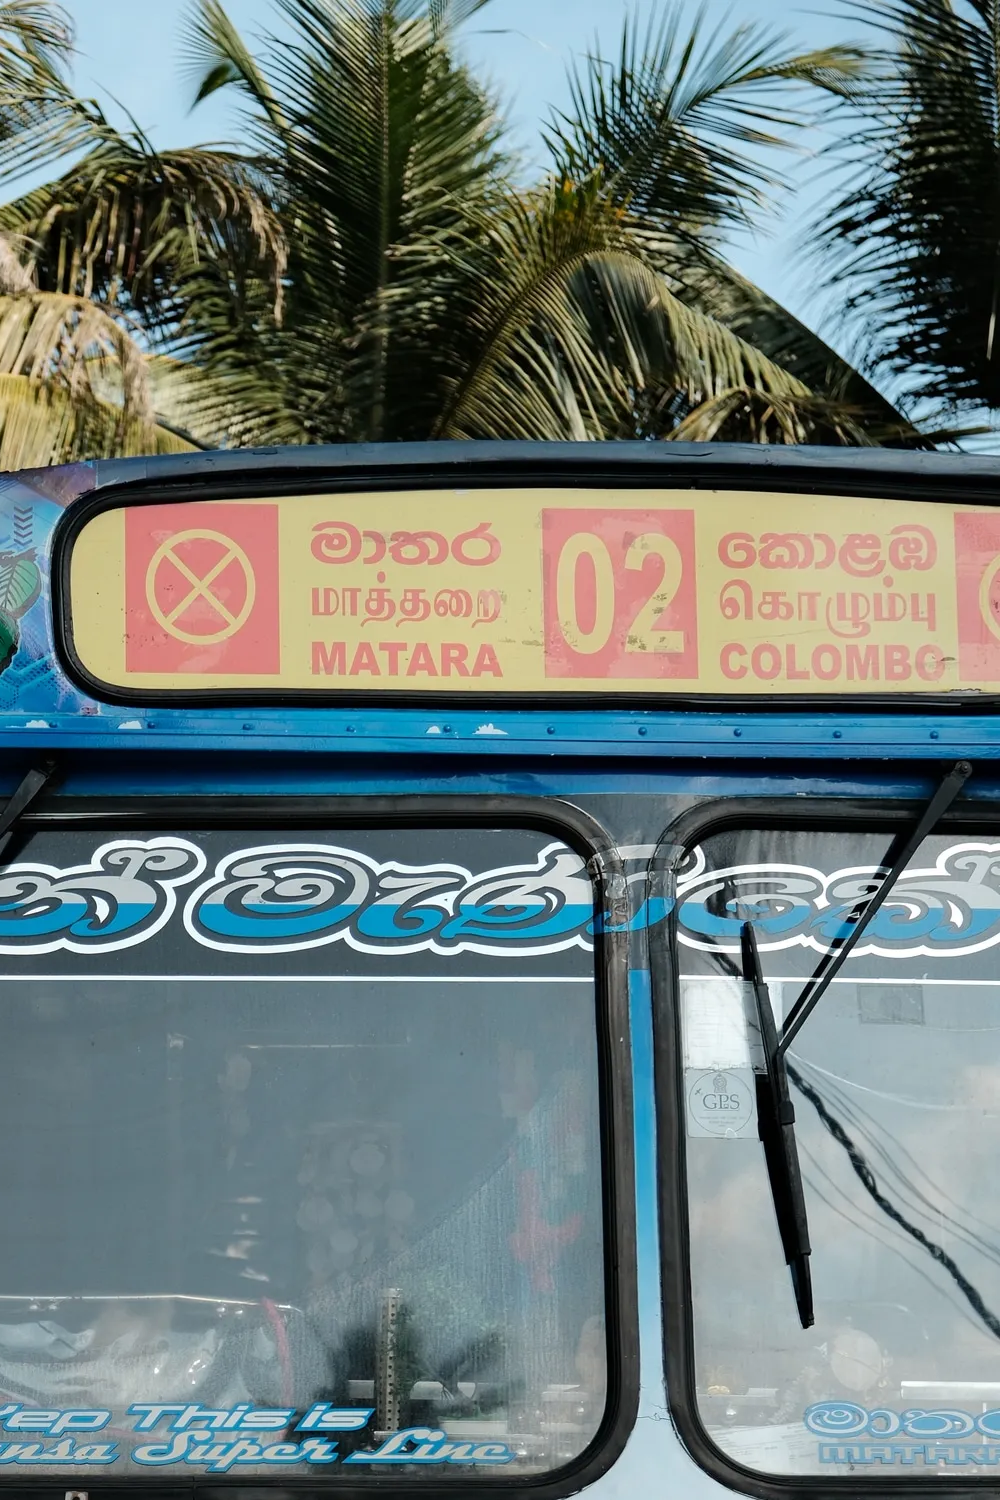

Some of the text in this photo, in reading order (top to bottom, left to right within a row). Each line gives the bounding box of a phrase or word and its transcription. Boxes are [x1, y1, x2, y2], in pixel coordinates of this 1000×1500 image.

[310, 520, 502, 566] මාතර
[717, 524, 939, 578] කොළඹ
[311, 571, 502, 629] மாத்தறை
[556, 532, 686, 655] 02
[719, 574, 938, 639] கொழும்பு
[311, 641, 504, 678] MATARA
[719, 643, 946, 682] COLOMBO
[702, 1093, 740, 1110] GPS
[126, 1402, 295, 1432] This
[294, 1402, 375, 1432] is
[131, 1429, 339, 1473] Super
[342, 1427, 516, 1464] Line
